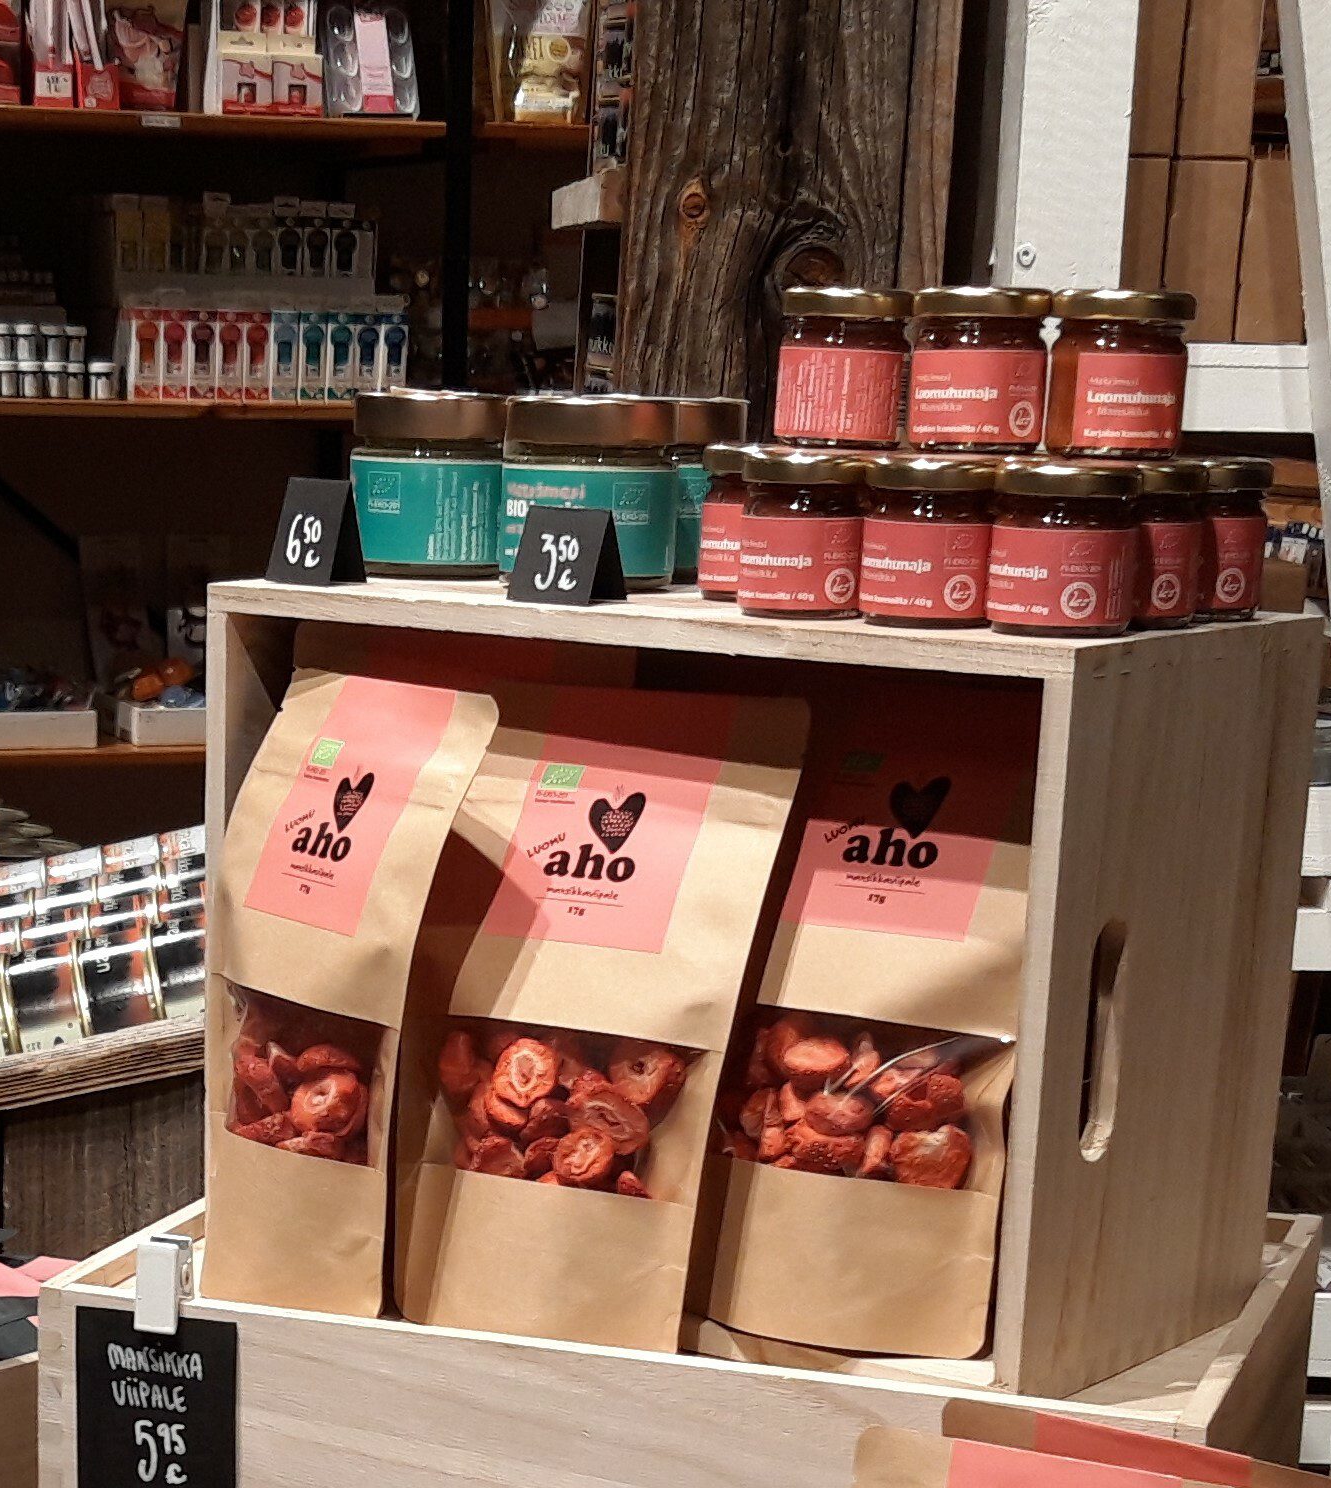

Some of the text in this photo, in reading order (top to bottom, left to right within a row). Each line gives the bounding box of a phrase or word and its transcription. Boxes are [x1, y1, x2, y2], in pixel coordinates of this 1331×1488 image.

[291, 822, 352, 863] aho
[526, 832, 567, 859] LUOMU
[842, 827, 939, 870] aho
[543, 843, 636, 883] aho
